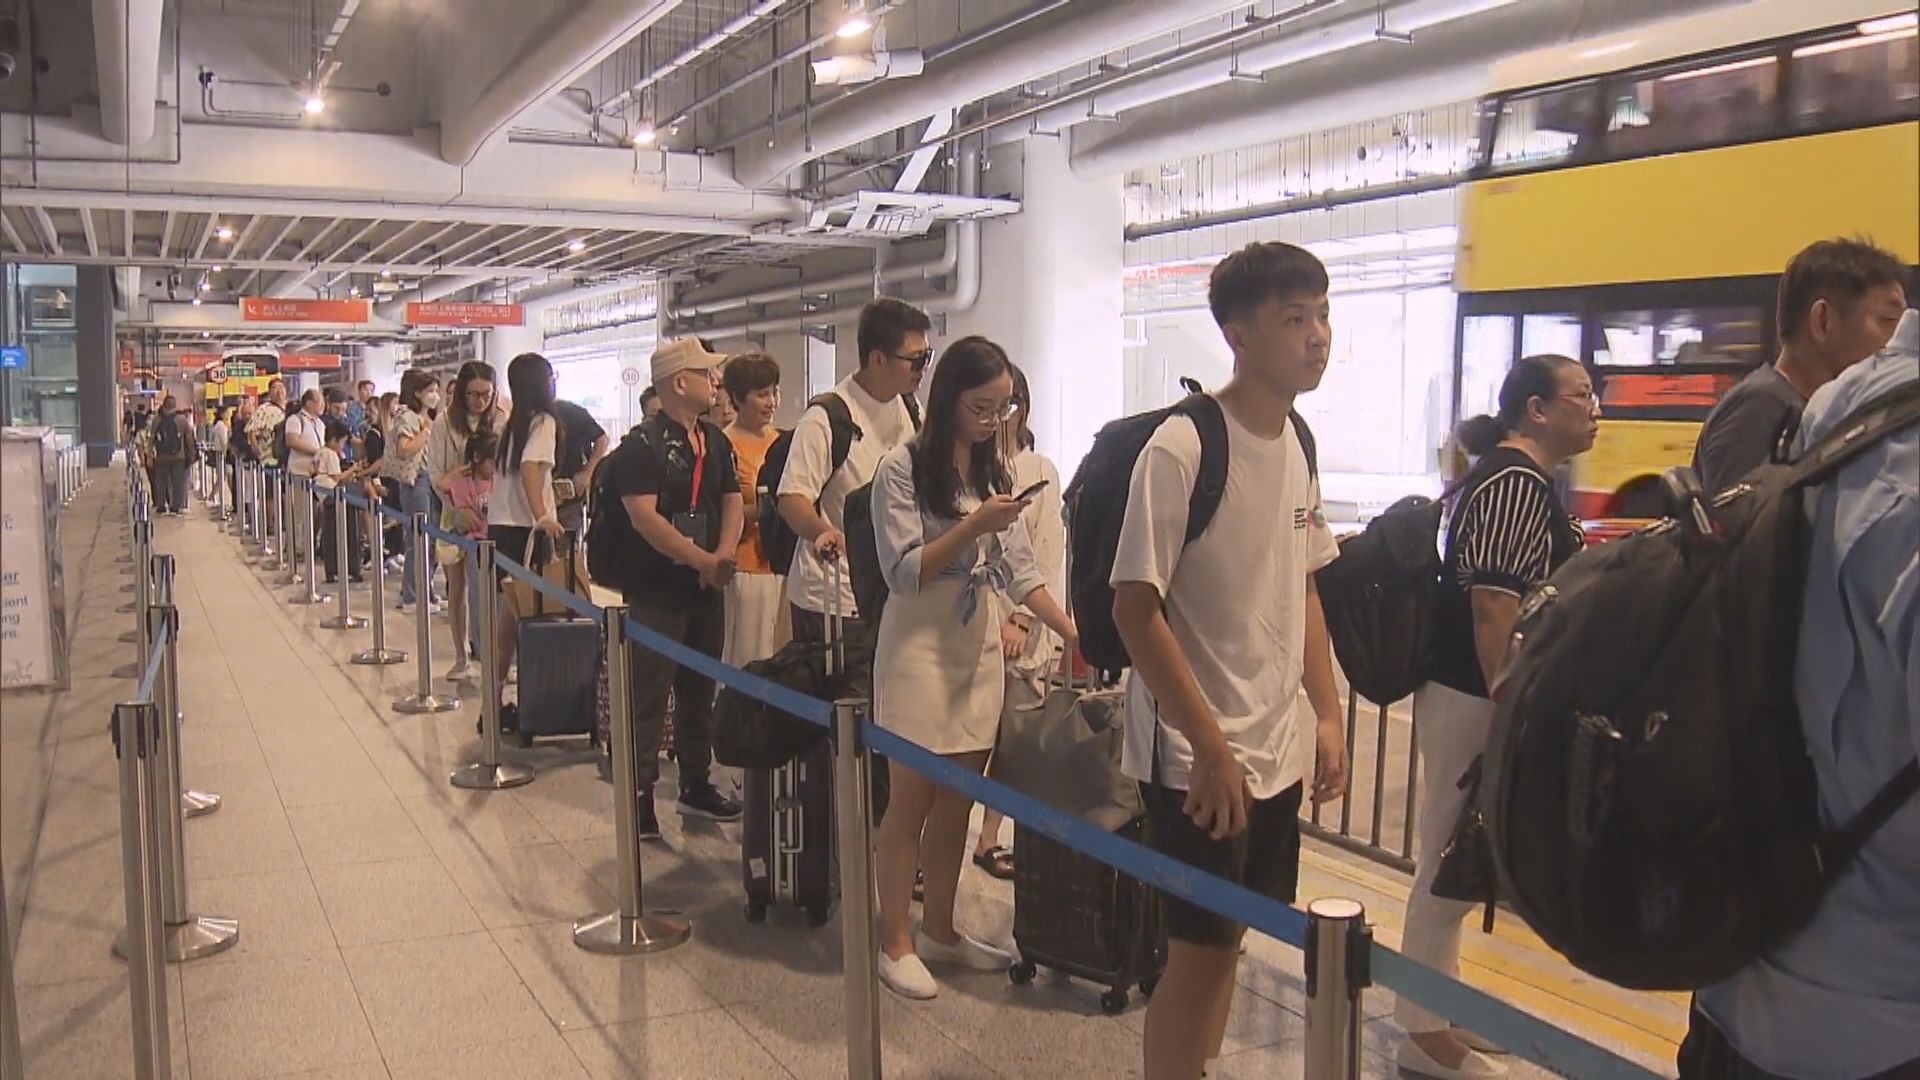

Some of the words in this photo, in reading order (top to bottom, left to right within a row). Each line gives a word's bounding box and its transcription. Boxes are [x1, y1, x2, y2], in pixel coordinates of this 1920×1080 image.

[120, 360, 131, 375] B
[213, 370, 226, 379] 30
[626, 371, 637, 381] 30
[1, 571, 20, 583] er
[1, 595, 28, 608] ient
